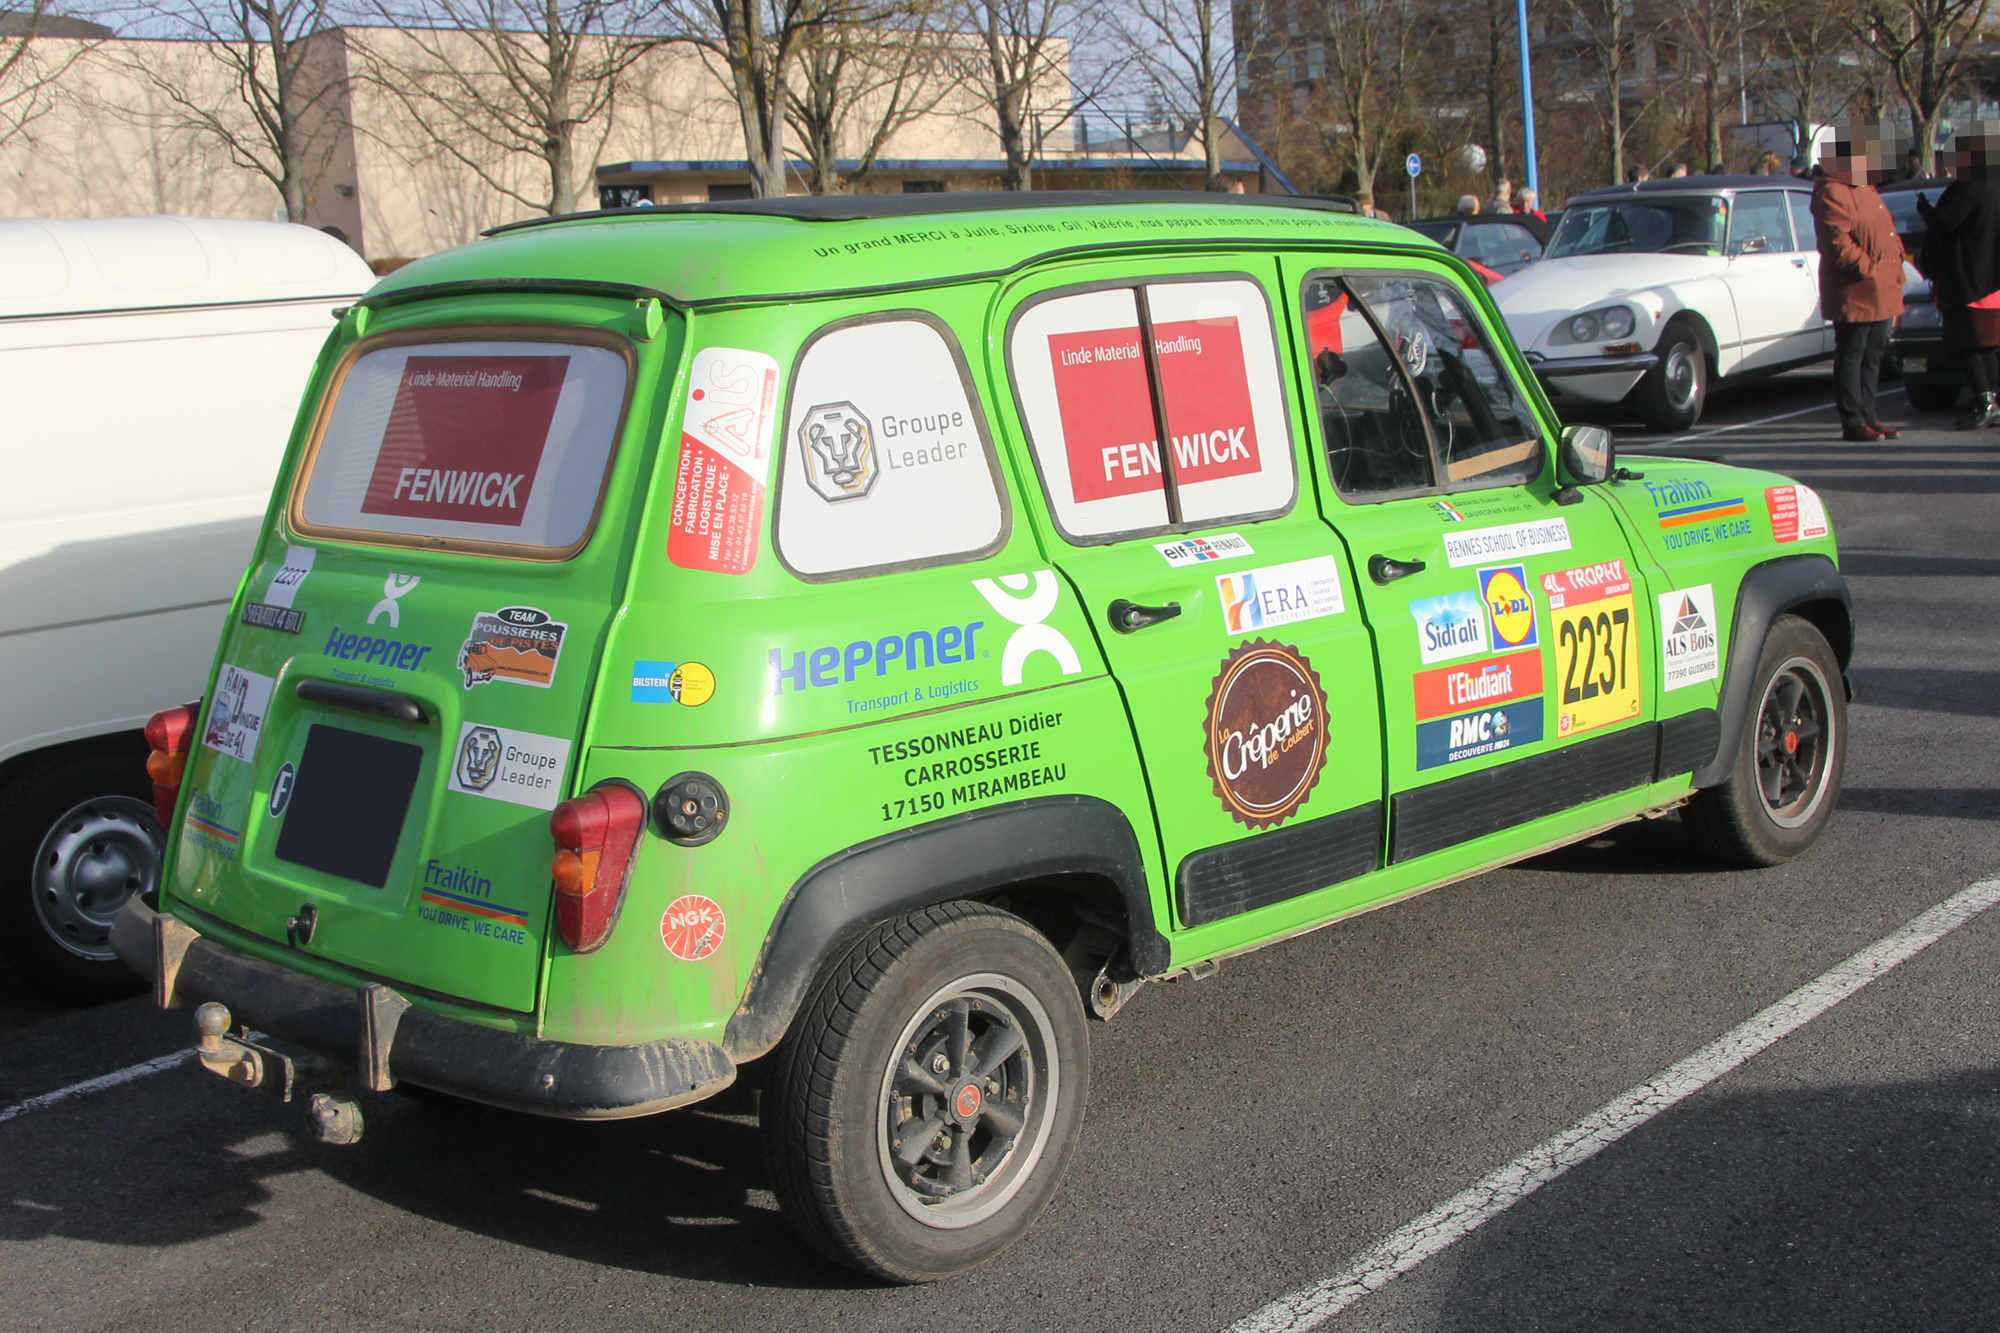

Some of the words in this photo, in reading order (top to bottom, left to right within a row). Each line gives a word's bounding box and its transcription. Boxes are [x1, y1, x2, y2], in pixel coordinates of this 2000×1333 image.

[813, 246, 840, 258] Un
[844, 237, 892, 254] grand
[893, 230, 947, 245] MERCI
[949, 228, 960, 239] à
[964, 224, 1005, 239] Julie,
[1005, 221, 1061, 235] Sixtine,
[1061, 220, 1088, 232] Gil,
[1089, 217, 1139, 231] Valérie,
[1140, 218, 1162, 228] nos
[1165, 217, 1200, 229] papas
[1203, 217, 1216, 226] et
[1218, 217, 1269, 228] mamans,
[1270, 217, 1290, 226] nos
[1061, 347, 1093, 366] Linde
[1094, 341, 1141, 363] Material
[1155, 335, 1202, 355] Handling
[408, 370, 434, 387] Linde
[436, 371, 475, 388] Material
[476, 372, 523, 392] Handling
[882, 411, 963, 438] Groupe
[887, 441, 967, 470] Leader
[1101, 427, 1251, 481] FENWICK
[393, 467, 524, 508] FENWICK
[672, 449, 691, 526] CONCEPTION
[684, 456, 704, 534] FABRICATION
[698, 464, 717, 535] LOGISTIQUE
[715, 471, 730, 512] PLACE
[1643, 478, 1712, 507] Fraikin
[712, 514, 723, 530] EN
[1663, 534, 1682, 551] YOU
[1685, 527, 1714, 547] DRIVE,
[1713, 524, 1728, 541] WE
[1729, 520, 1752, 538] CARE
[709, 533, 722, 560] MISE
[1164, 545, 1188, 559] elf
[1189, 545, 1213, 553] TEAM
[1211, 537, 1246, 551] RENAULT
[1446, 538, 1483, 559] RENNES
[1483, 533, 1516, 554] SCHOOL
[1516, 531, 1527, 547] OF
[1529, 524, 1568, 545] BUSINESS
[274, 566, 308, 586] 2237
[1544, 574, 1566, 593] 4L
[1566, 560, 1623, 589] TROPHY
[248, 605, 281, 627] RENAULT
[276, 610, 287, 628] 4
[284, 611, 299, 631] GTL
[473, 622, 558, 642] POUSSIERES
[509, 610, 537, 623] TEAM
[1266, 609, 1311, 625] ENTREPRISE
[490, 637, 507, 646] DE
[510, 638, 558, 650] PISTES
[1425, 621, 1456, 651] Sidi
[1459, 618, 1478, 642] ali
[1666, 635, 1686, 658] ALS
[1690, 629, 1714, 652] Bois
[1560, 608, 1629, 706] 2237
[1668, 668, 1687, 681] 77390
[1688, 660, 1715, 676] GUIGNES
[330, 668, 361, 682] Transport
[367, 675, 396, 688] Logistics
[633, 677, 668, 688] BILSTEIN
[846, 691, 909, 715] Transport
[914, 687, 925, 702] &
[928, 679, 980, 700] Logistics
[868, 722, 1003, 767] TESSONNEAU
[1009, 711, 1064, 736] Didier
[1218, 728, 1231, 744] La
[1222, 689, 1312, 780] Crêperie
[1267, 750, 1279, 765] de
[1281, 718, 1314, 753] Coubert
[1449, 712, 1492, 749] RMC
[506, 746, 557, 770] Groupe
[903, 741, 1042, 788] CARROSSERIE
[1449, 743, 1493, 762] DECOUVERTE
[272, 771, 292, 808] F
[501, 767, 552, 789] Leader
[881, 792, 946, 822] 17150
[951, 763, 1068, 807] MIRAMBEAU
[192, 788, 223, 820] Fraikin
[424, 859, 491, 898] Fraikin
[418, 905, 436, 922] YOU
[438, 910, 470, 933] DRIVE,
[474, 921, 492, 938] WE
[493, 927, 525, 945] CARE
[670, 907, 713, 930] NGK
